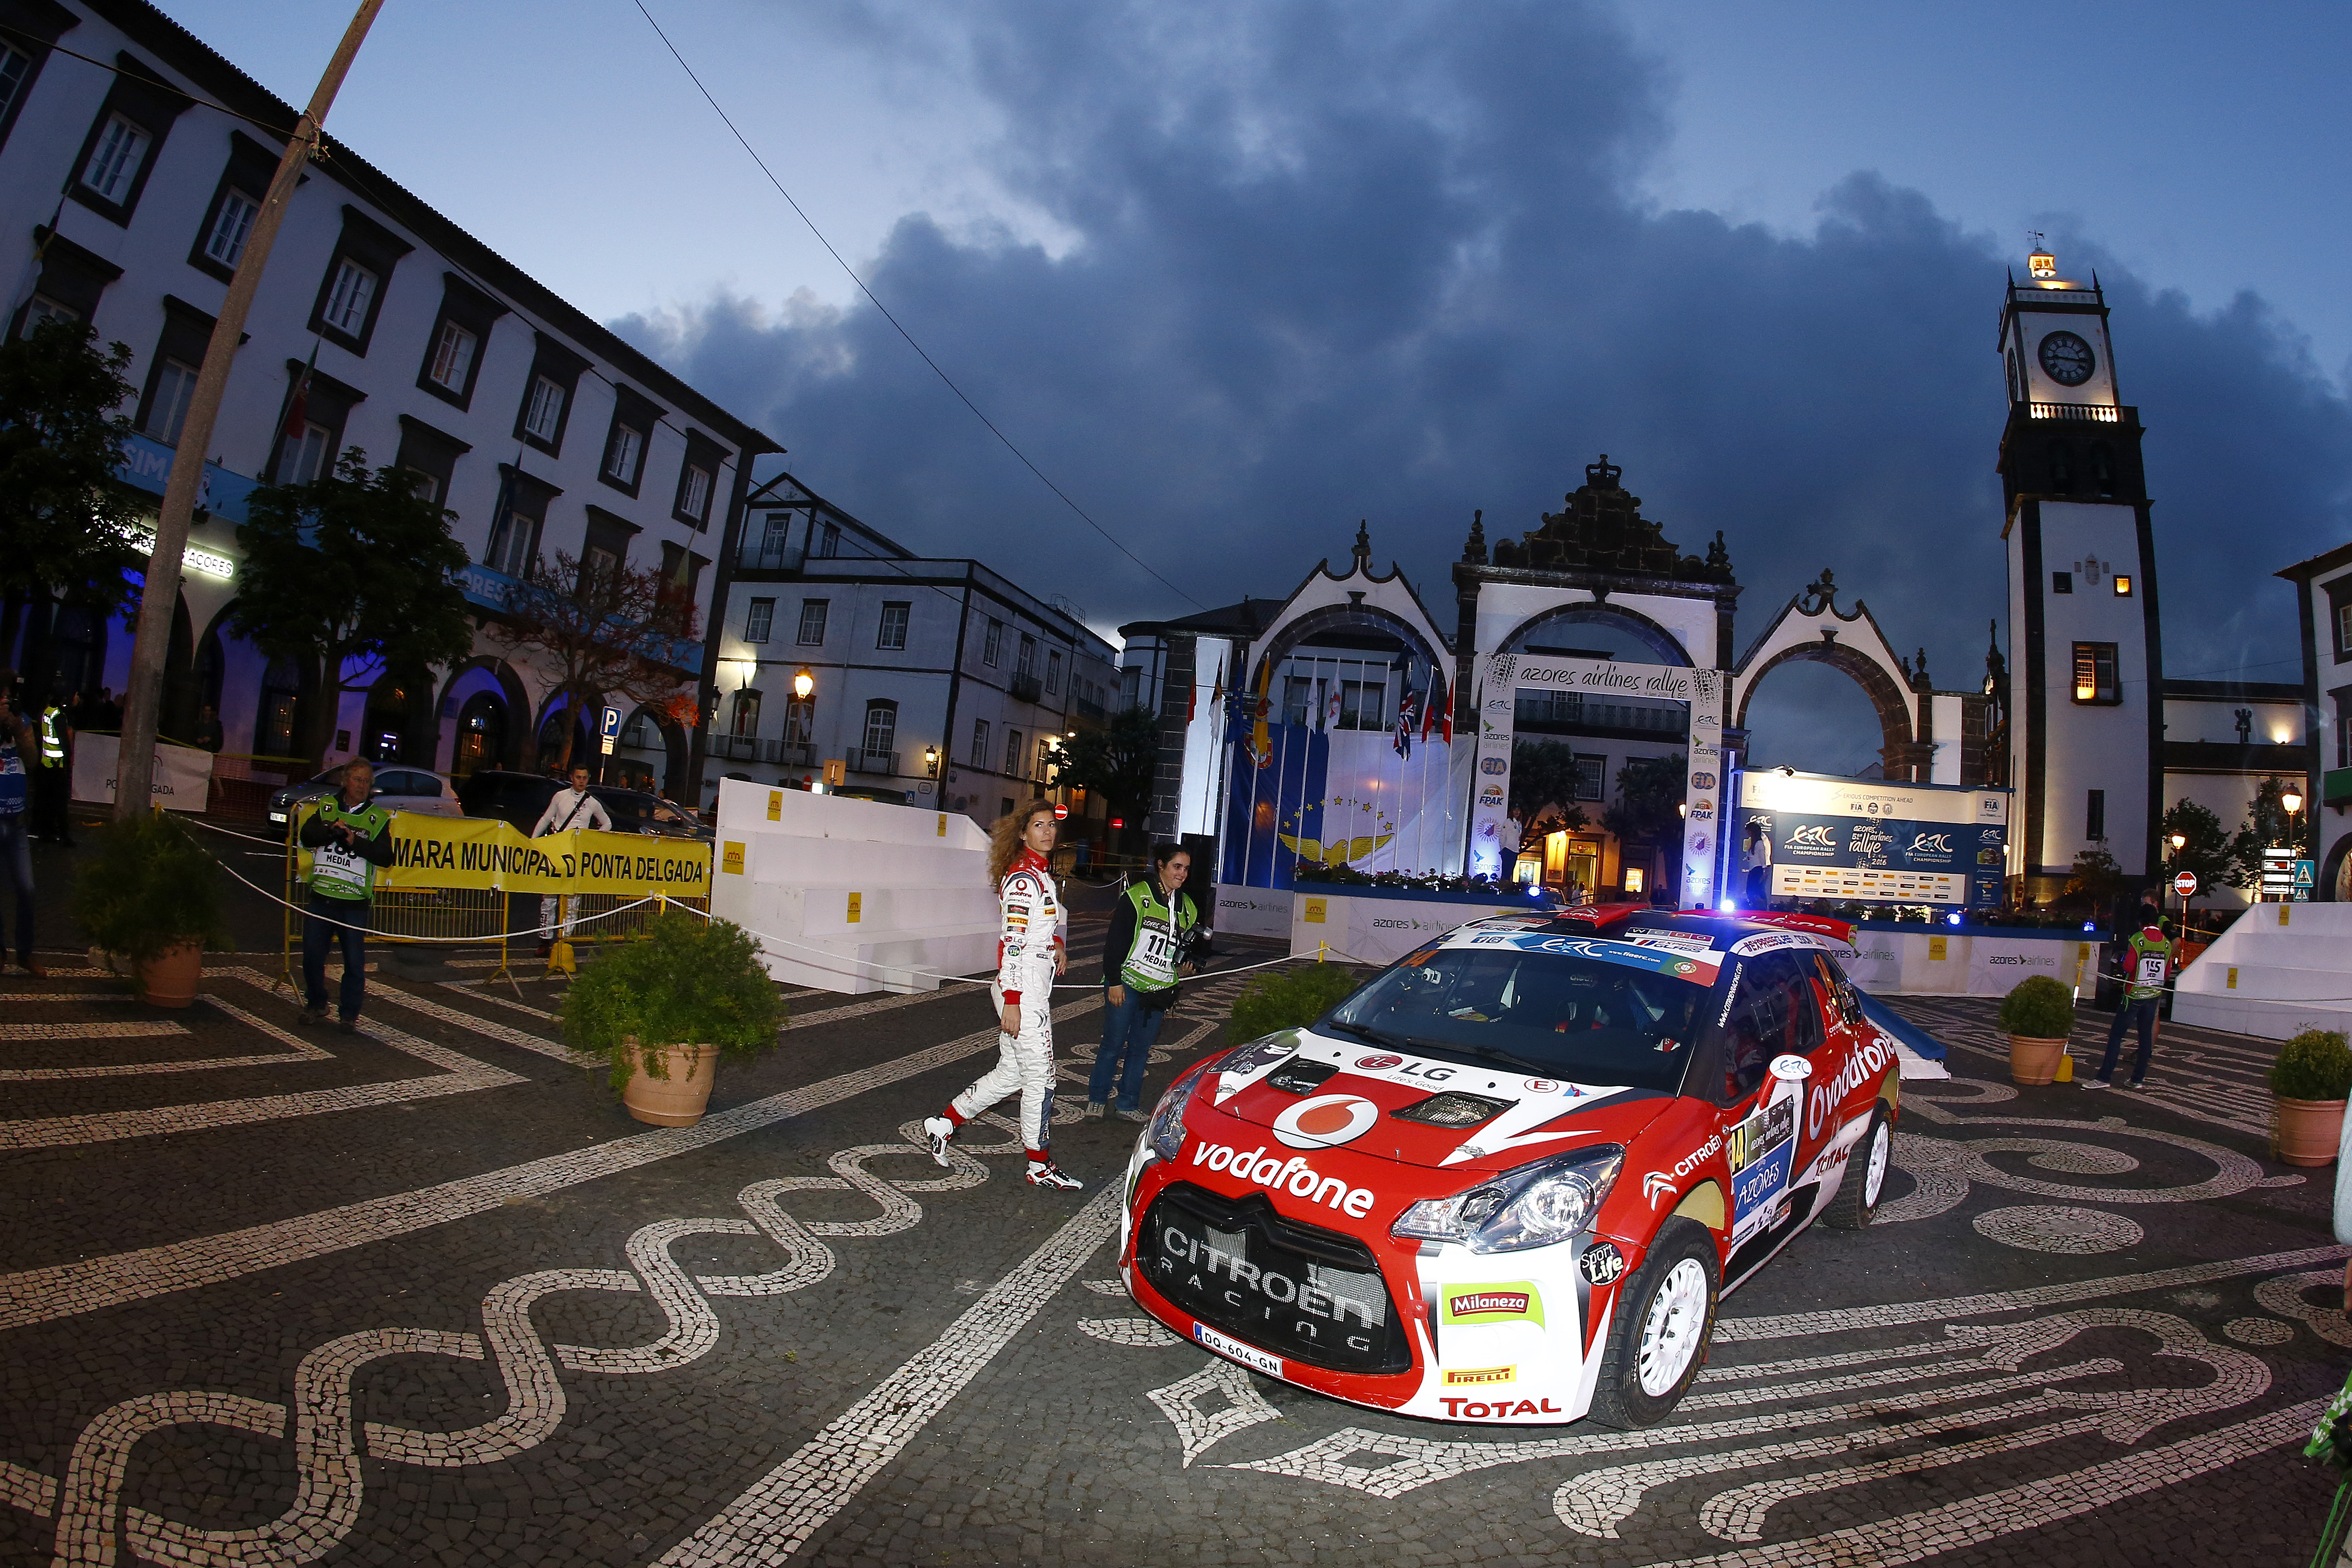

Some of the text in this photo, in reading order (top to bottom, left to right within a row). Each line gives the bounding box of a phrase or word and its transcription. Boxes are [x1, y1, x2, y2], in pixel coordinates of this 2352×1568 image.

[1521, 663, 1687, 698] azores airlines rallye
[604, 710, 617, 733] P
[1483, 741, 1509, 750] airlines
[1693, 756, 1718, 765] airlines
[152, 784, 175, 795] GADA
[1479, 796, 1504, 805] FPAK
[1690, 810, 1713, 820] FPAK
[1848, 833, 1882, 859] rallye
[326, 855, 351, 868] MEDIA
[387, 837, 455, 870] MARA
[461, 842, 561, 878] MUNICIPAL
[561, 854, 575, 878] D
[581, 852, 632, 879] PONTA
[636, 856, 702, 883] DELGADA
[1474, 863, 1501, 871] azores
[2176, 879, 2195, 887] STOP
[1219, 900, 1288, 914] azores airlines
[1373, 918, 1409, 929] azores
[1653, 943, 1702, 953] GLASS
[1657, 940, 1706, 950] EXPRESS
[1143, 952, 1167, 968] MEDIA
[1608, 949, 1662, 963] www.fiaerc.com
[1831, 949, 1895, 961] ores airlines
[1990, 955, 2055, 966] azores airlines
[1398, 1062, 1458, 1081] LG
[1825, 1032, 1895, 1116] vodafone
[1387, 1073, 1445, 1092] Life's Good
[1731, 1127, 1744, 1173] 14
[1192, 1141, 1375, 1219] vodafone
[1735, 1161, 1779, 1211] AZORES
[1581, 1243, 1615, 1269] Sport
[1589, 1254, 1624, 1283] Life
[1455, 1295, 1526, 1311] Milaneza
[1205, 1332, 1278, 1373] DQ-604-GN
[1447, 1368, 1511, 1383] PIRELLI
[1439, 1397, 1562, 1418] TOTAL
